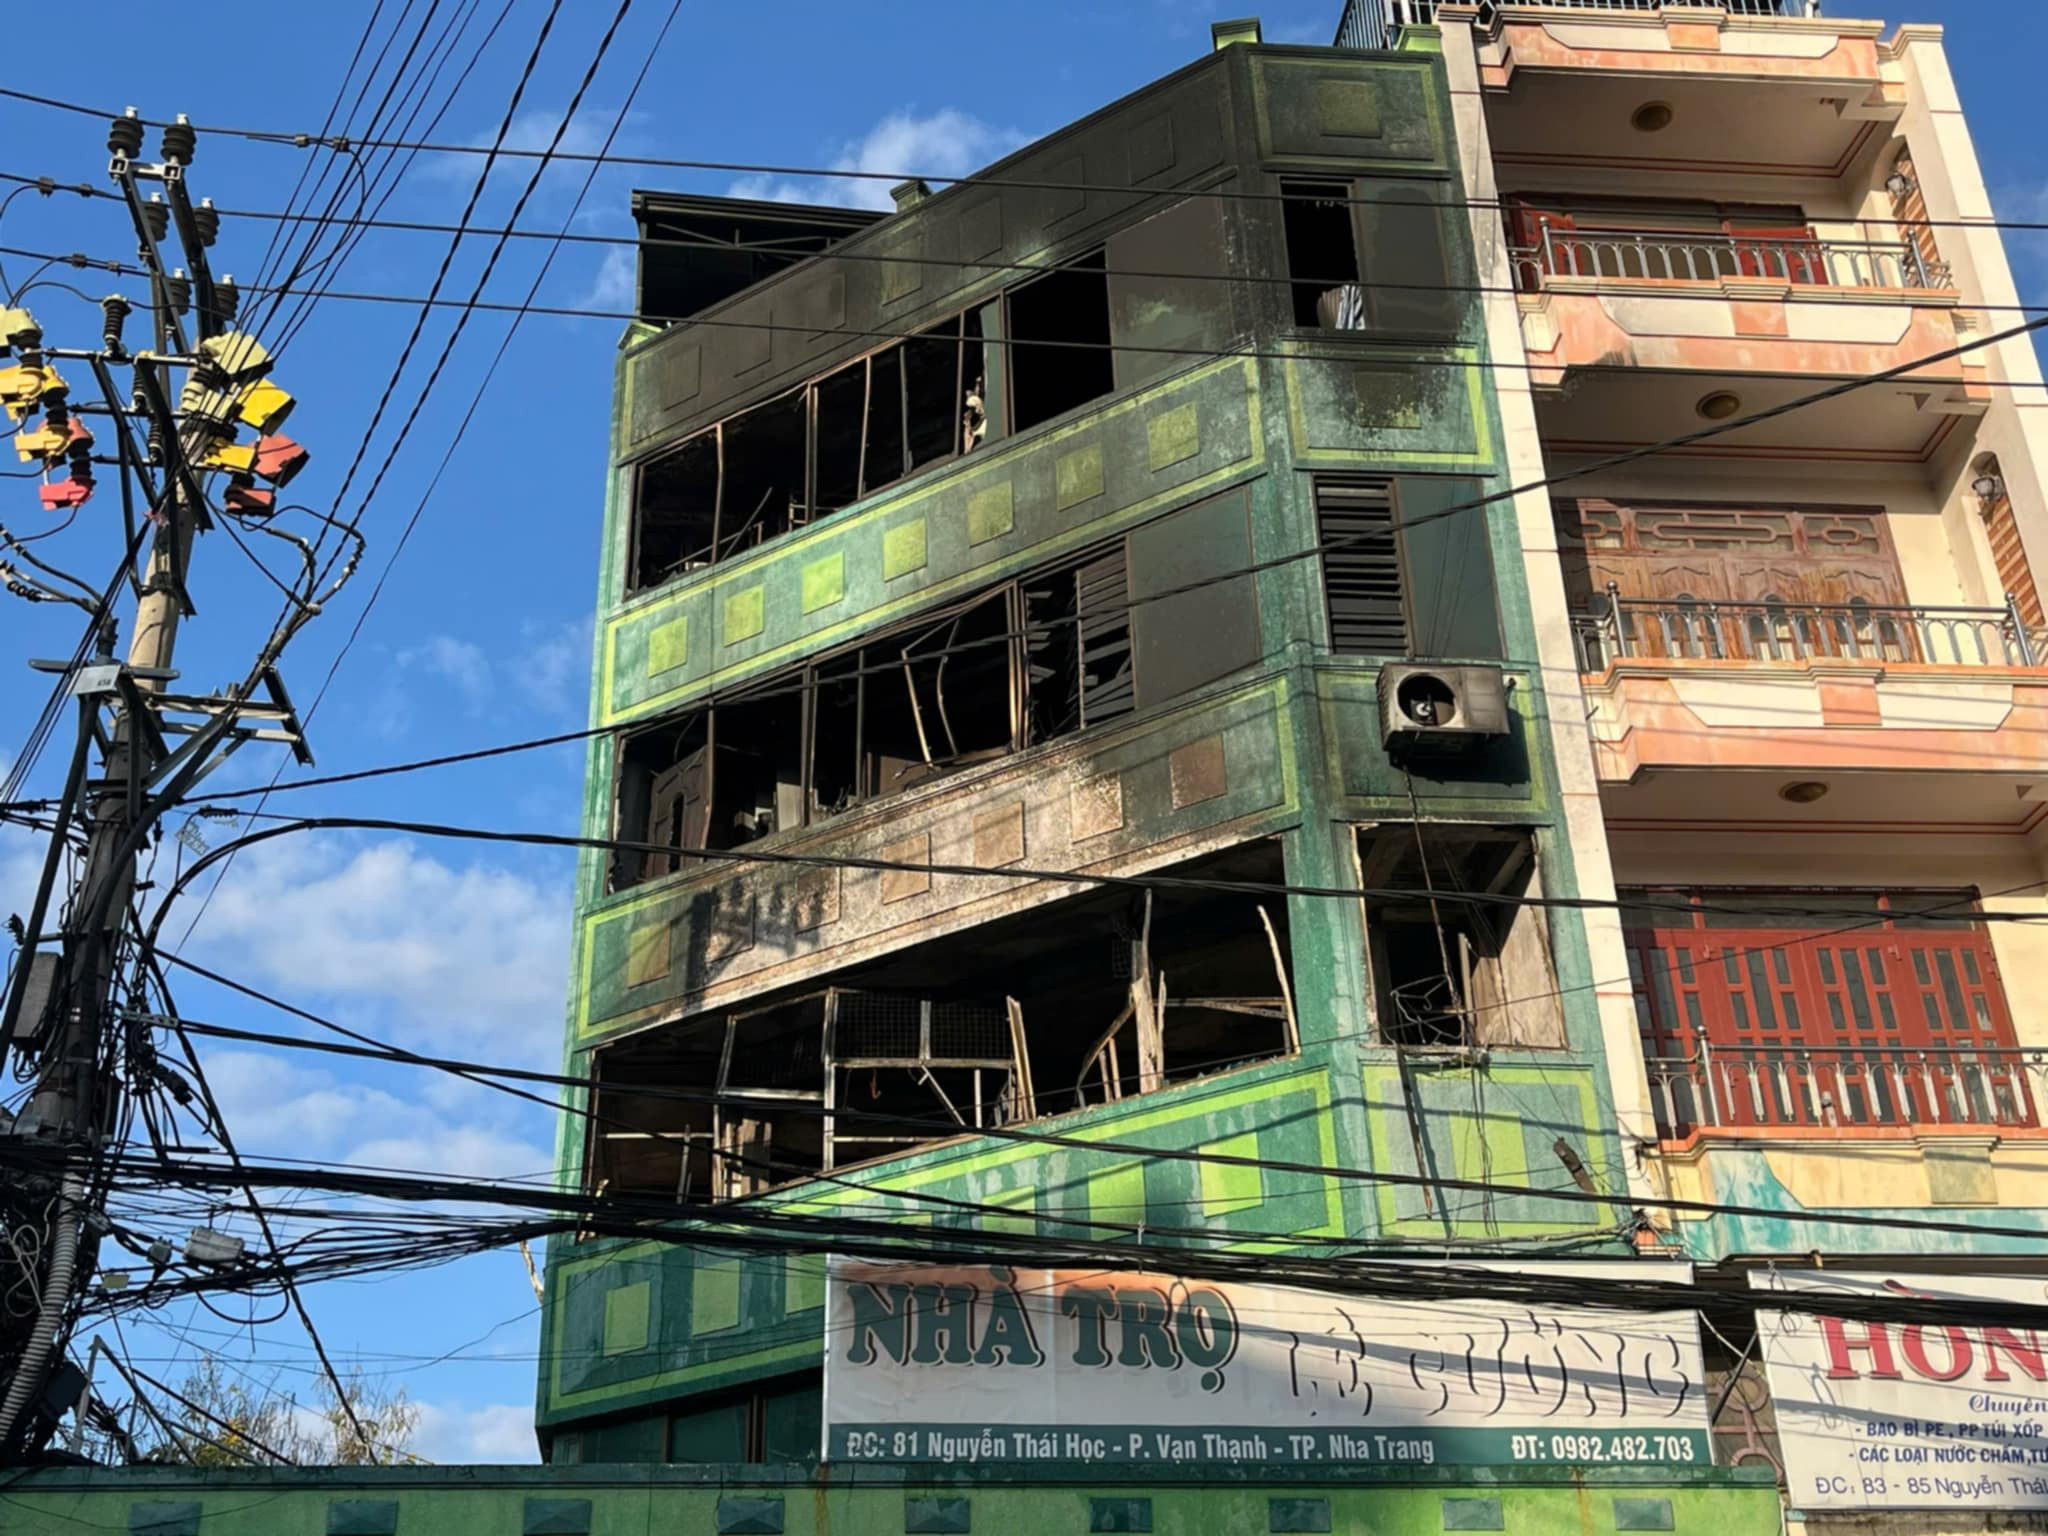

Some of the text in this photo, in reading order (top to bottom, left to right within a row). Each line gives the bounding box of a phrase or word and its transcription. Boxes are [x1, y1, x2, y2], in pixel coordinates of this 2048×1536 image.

[847, 1266, 1239, 1392] NHÀ TRỌ
[1867, 1422, 1897, 1437] BAO
[1959, 1424, 1979, 1437] PP
[2013, 1418, 2043, 1438] XỐP
[847, 1431, 886, 1458] ĐC:
[894, 1431, 918, 1457] 81
[928, 1428, 1006, 1463] Nguyễn
[1013, 1433, 1058, 1458] Thái
[1066, 1433, 1105, 1464] Học
[1129, 1434, 1150, 1458] P.
[1156, 1434, 1197, 1464] Vạn
[1203, 1434, 1267, 1464] Thạnh
[1289, 1435, 1323, 1460] TP.
[1329, 1435, 1369, 1459] Nha
[1375, 1435, 1435, 1464] Trang
[1511, 1435, 1695, 1462] ĐT: 0982.482.703
[1859, 1443, 1889, 1462] CÁC
[1895, 1447, 1928, 1465] LOẠI
[1935, 1443, 1976, 1463] NƯỚC
[1862, 1477, 1886, 1494] 83
[1908, 1477, 1931, 1494] 85
[1934, 1475, 2003, 1499] Nguyễn
